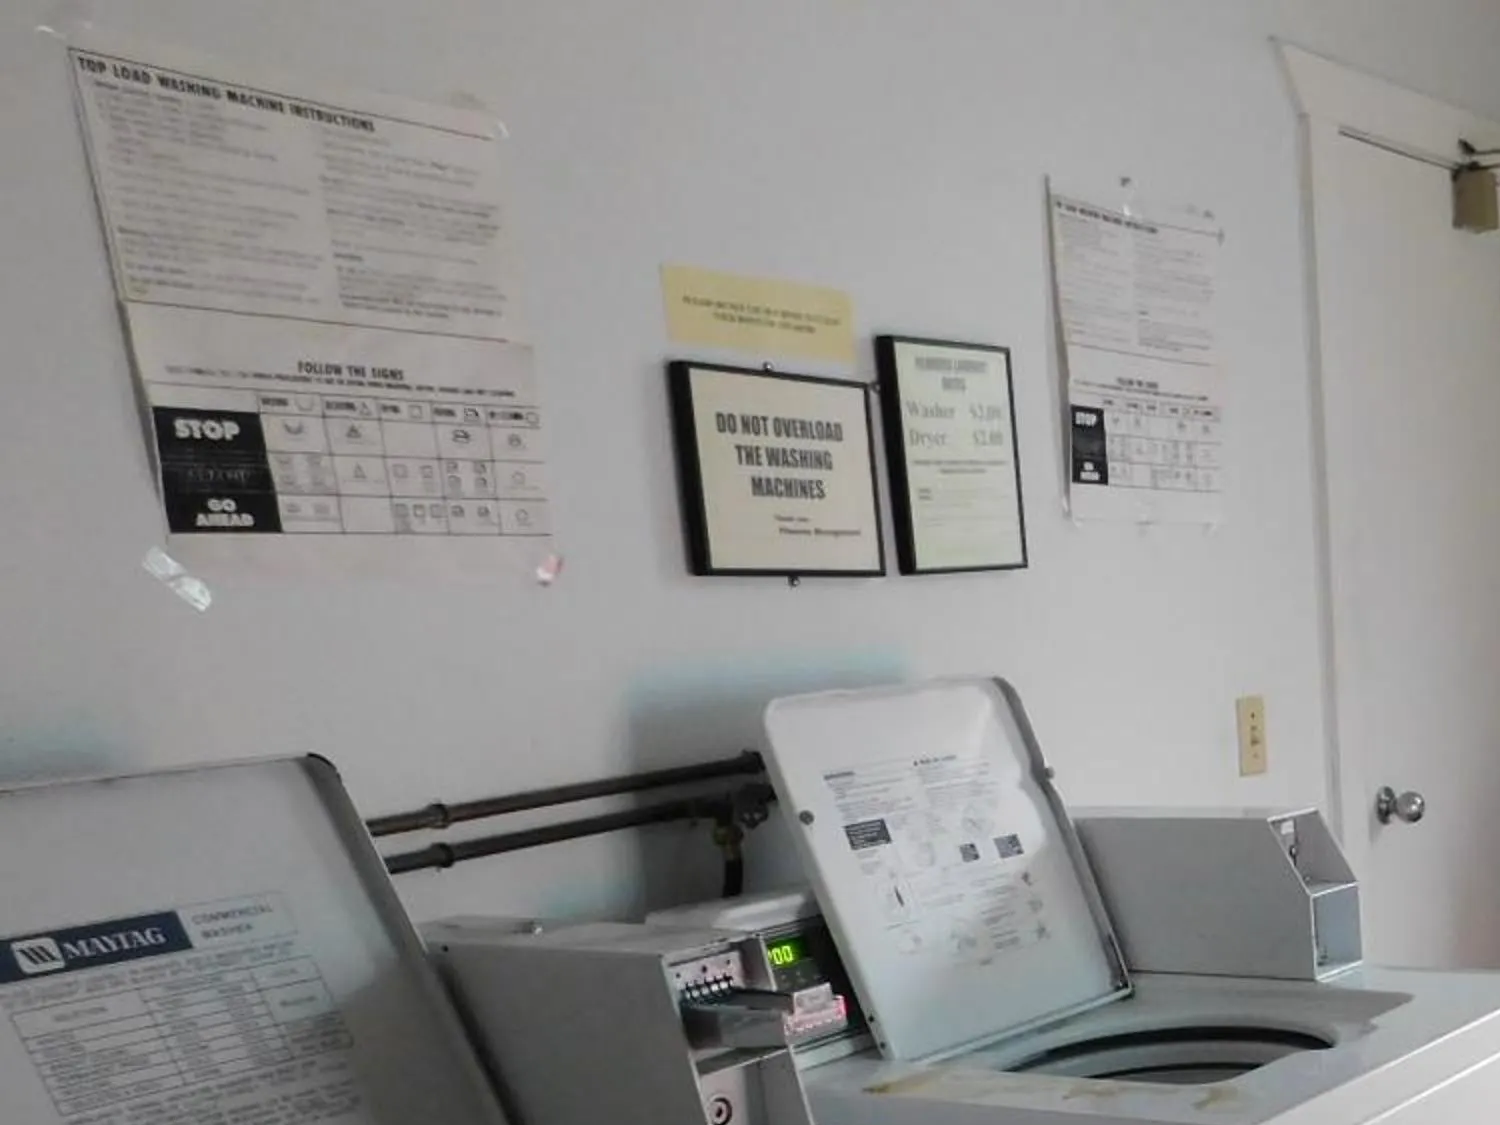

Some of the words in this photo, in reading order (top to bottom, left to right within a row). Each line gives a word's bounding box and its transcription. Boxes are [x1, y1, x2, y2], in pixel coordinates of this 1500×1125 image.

[78, 57, 106, 73] TOP
[112, 64, 150, 84] LOAD
[156, 75, 221, 99] WASHING
[226, 90, 284, 113] MACHINE
[289, 103, 375, 132] INSTRUCTIONS
[297, 361, 342, 376] FOLLOW
[346, 365, 366, 378] THE
[371, 367, 404, 381] SIGNS
[174, 418, 240, 440] STOP
[716, 412, 737, 434] DO
[740, 414, 768, 436] NOT
[773, 417, 843, 441] OVERLOAD
[735, 444, 762, 466] THE
[765, 446, 833, 470] WASHING
[751, 476, 826, 499] MACHINES
[207, 498, 237, 512] GO
[62, 926, 167, 959] MAYTAG
